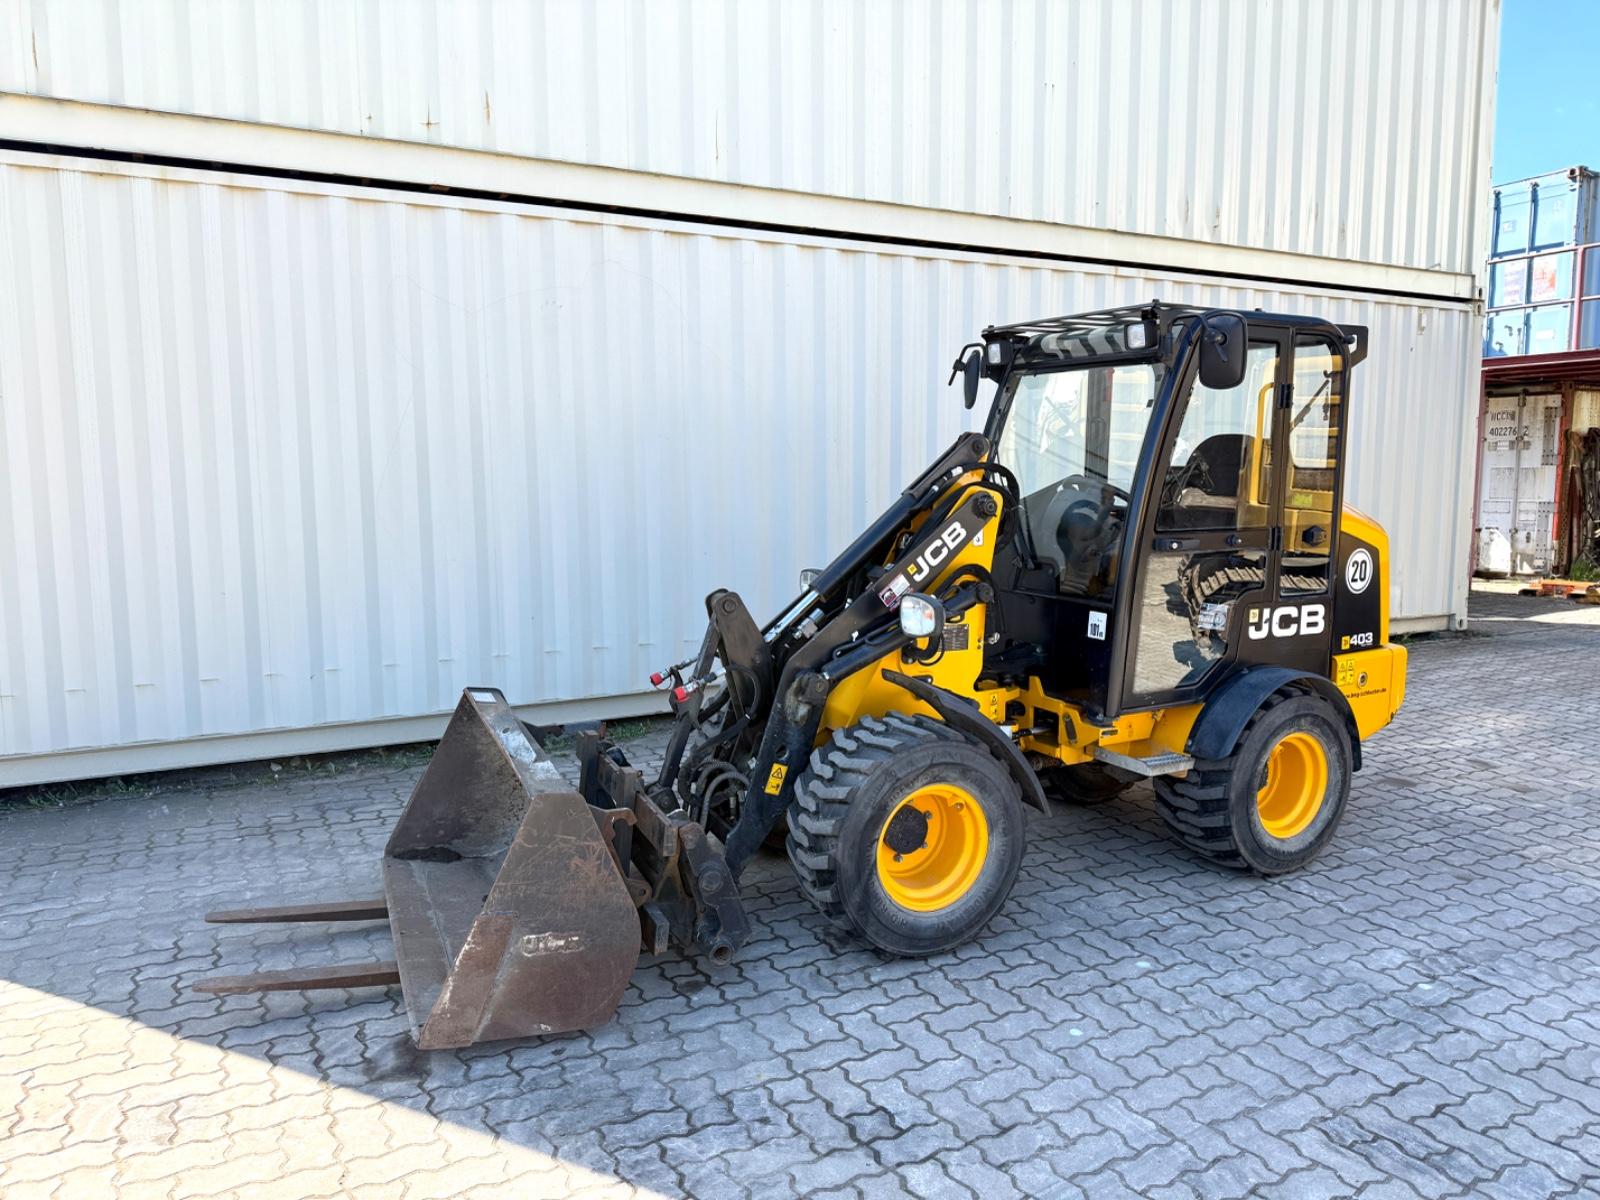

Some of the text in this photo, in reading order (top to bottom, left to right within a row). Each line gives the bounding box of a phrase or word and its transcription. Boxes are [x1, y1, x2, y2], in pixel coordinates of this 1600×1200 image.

[912, 521, 967, 582] JCB
[1351, 559, 1367, 582] 20
[1248, 603, 1326, 640] JCB
[1350, 632, 1373, 646] 403
